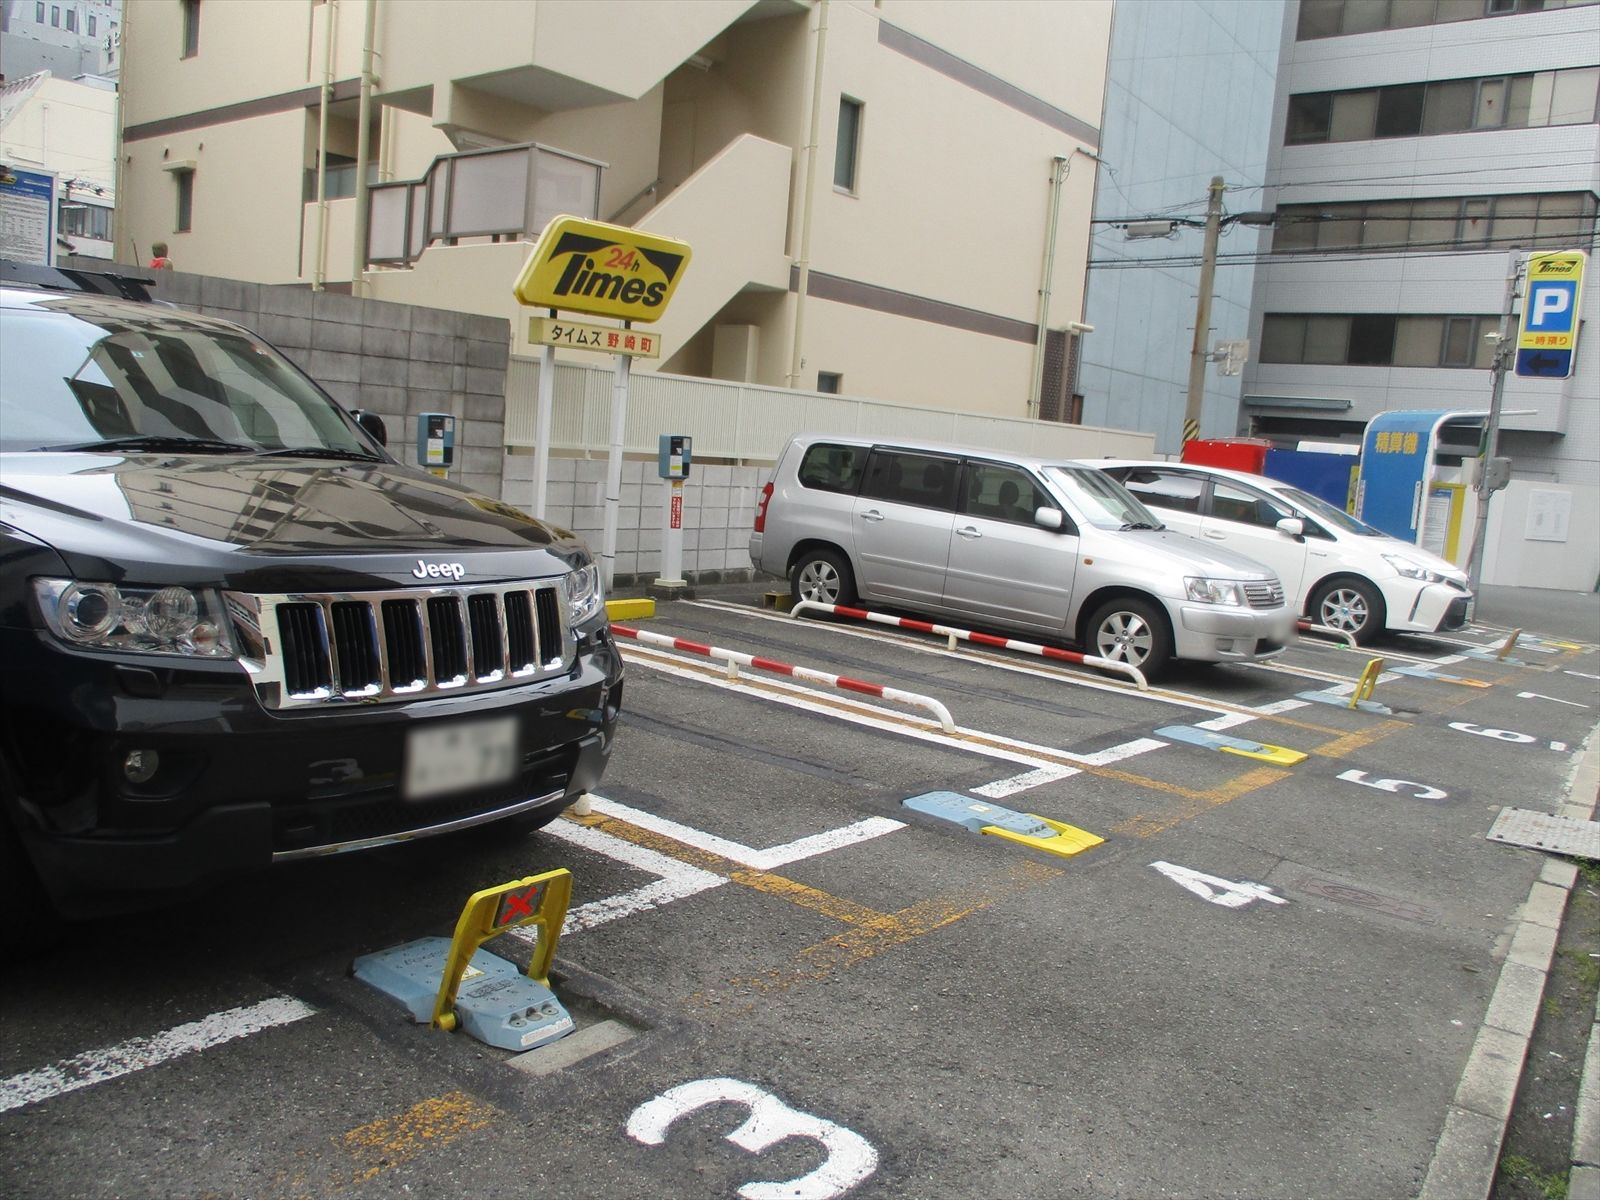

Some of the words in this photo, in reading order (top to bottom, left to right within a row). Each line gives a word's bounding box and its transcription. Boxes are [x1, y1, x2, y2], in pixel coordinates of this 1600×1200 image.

[548, 232, 668, 308] Times
[1531, 288, 1570, 326] P
[551, 324, 602, 346] タイムズ
[412, 559, 465, 581] Jeep
[1335, 768, 1448, 800] 5
[1147, 860, 1290, 908] 4
[626, 1077, 879, 1200] 3
